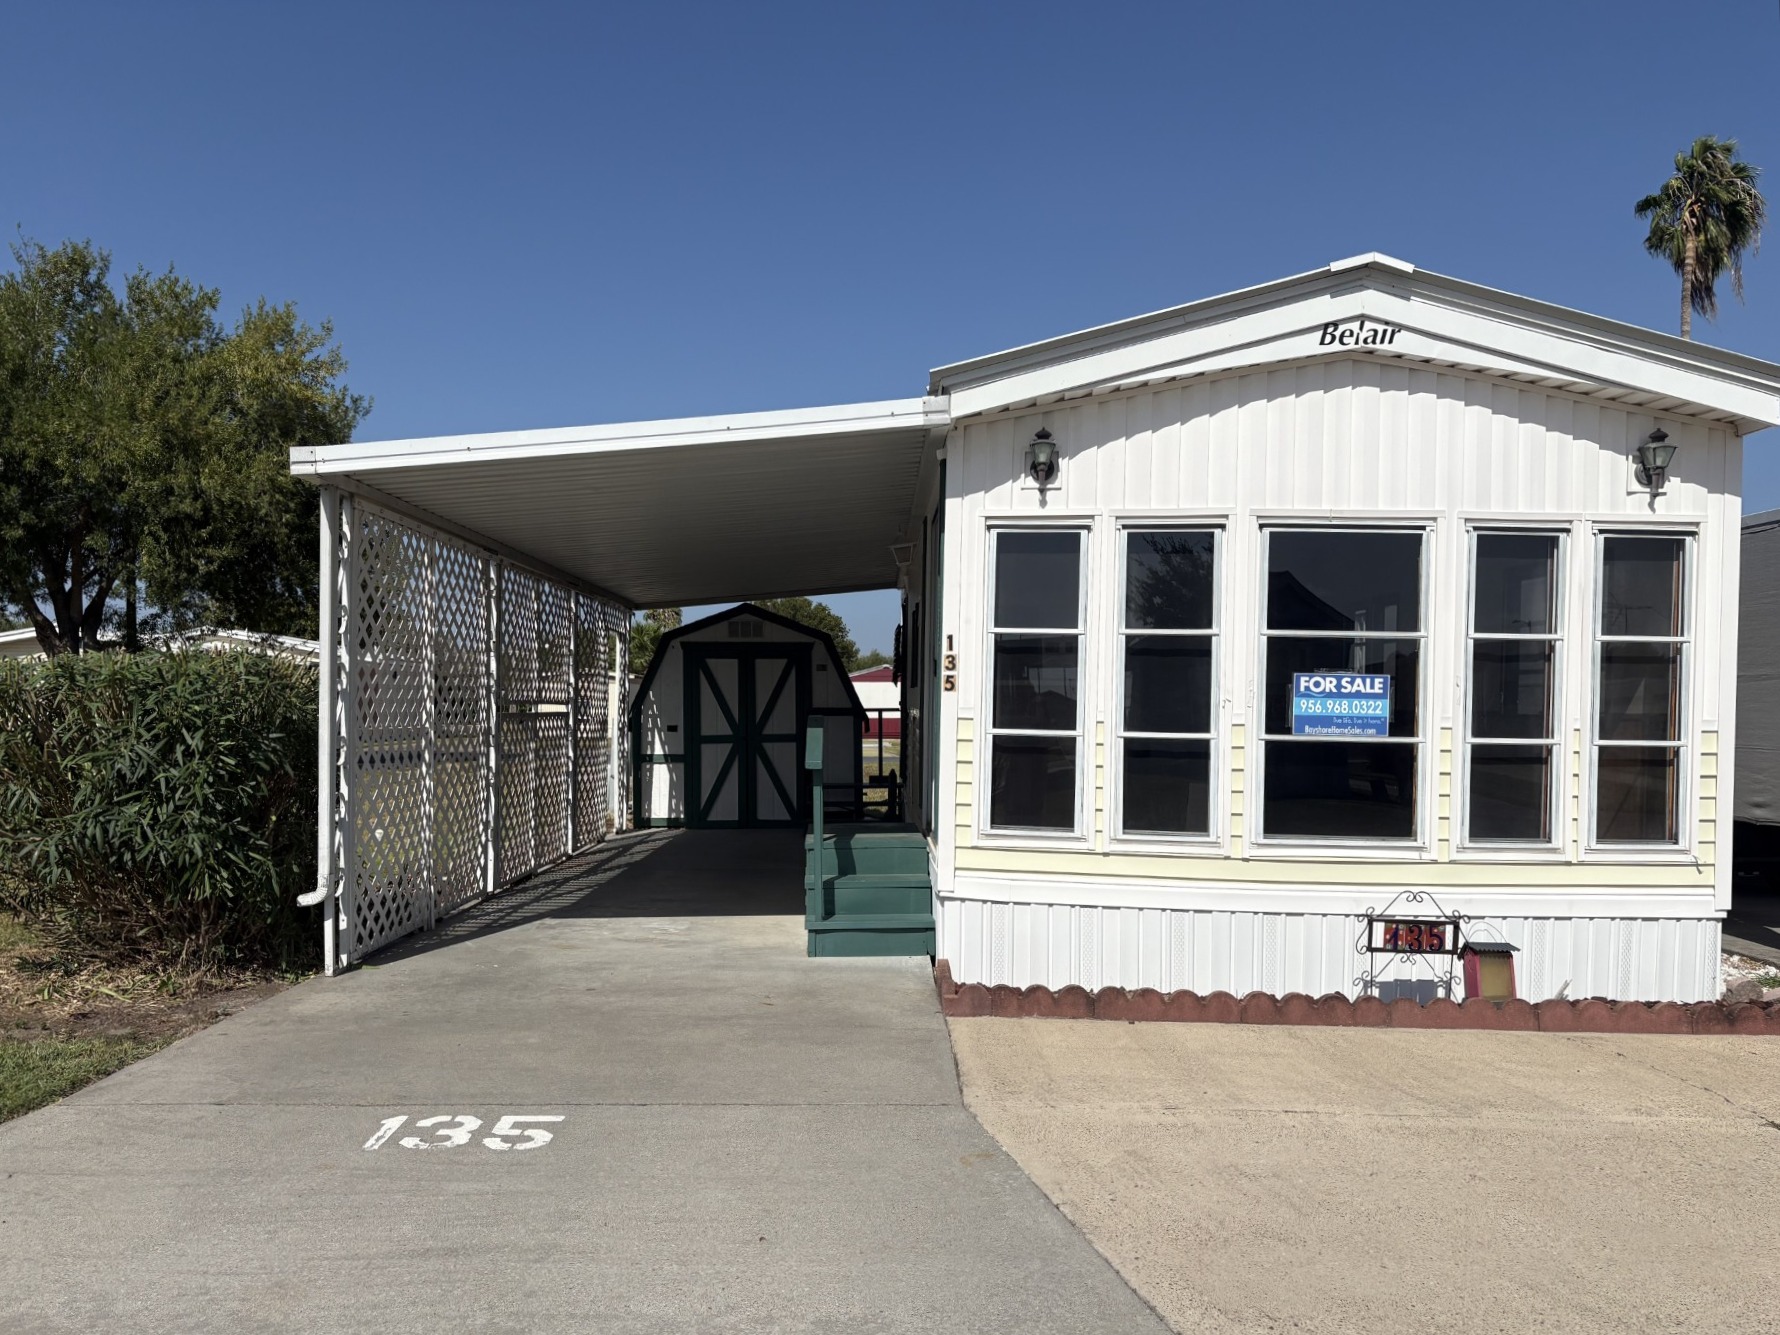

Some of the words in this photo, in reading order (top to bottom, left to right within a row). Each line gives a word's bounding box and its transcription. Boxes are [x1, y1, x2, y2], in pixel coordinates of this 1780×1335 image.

[1319, 320, 1402, 346] Belair
[944, 634, 957, 692] 135
[1300, 676, 1338, 693] FOR
[1341, 677, 1384, 694] SALE
[1300, 699, 1383, 715] 956.968.0322
[1304, 724, 1377, 735] BayshoreHomeSales.com
[1387, 923, 1444, 951] 135
[362, 1115, 566, 1150] 135
